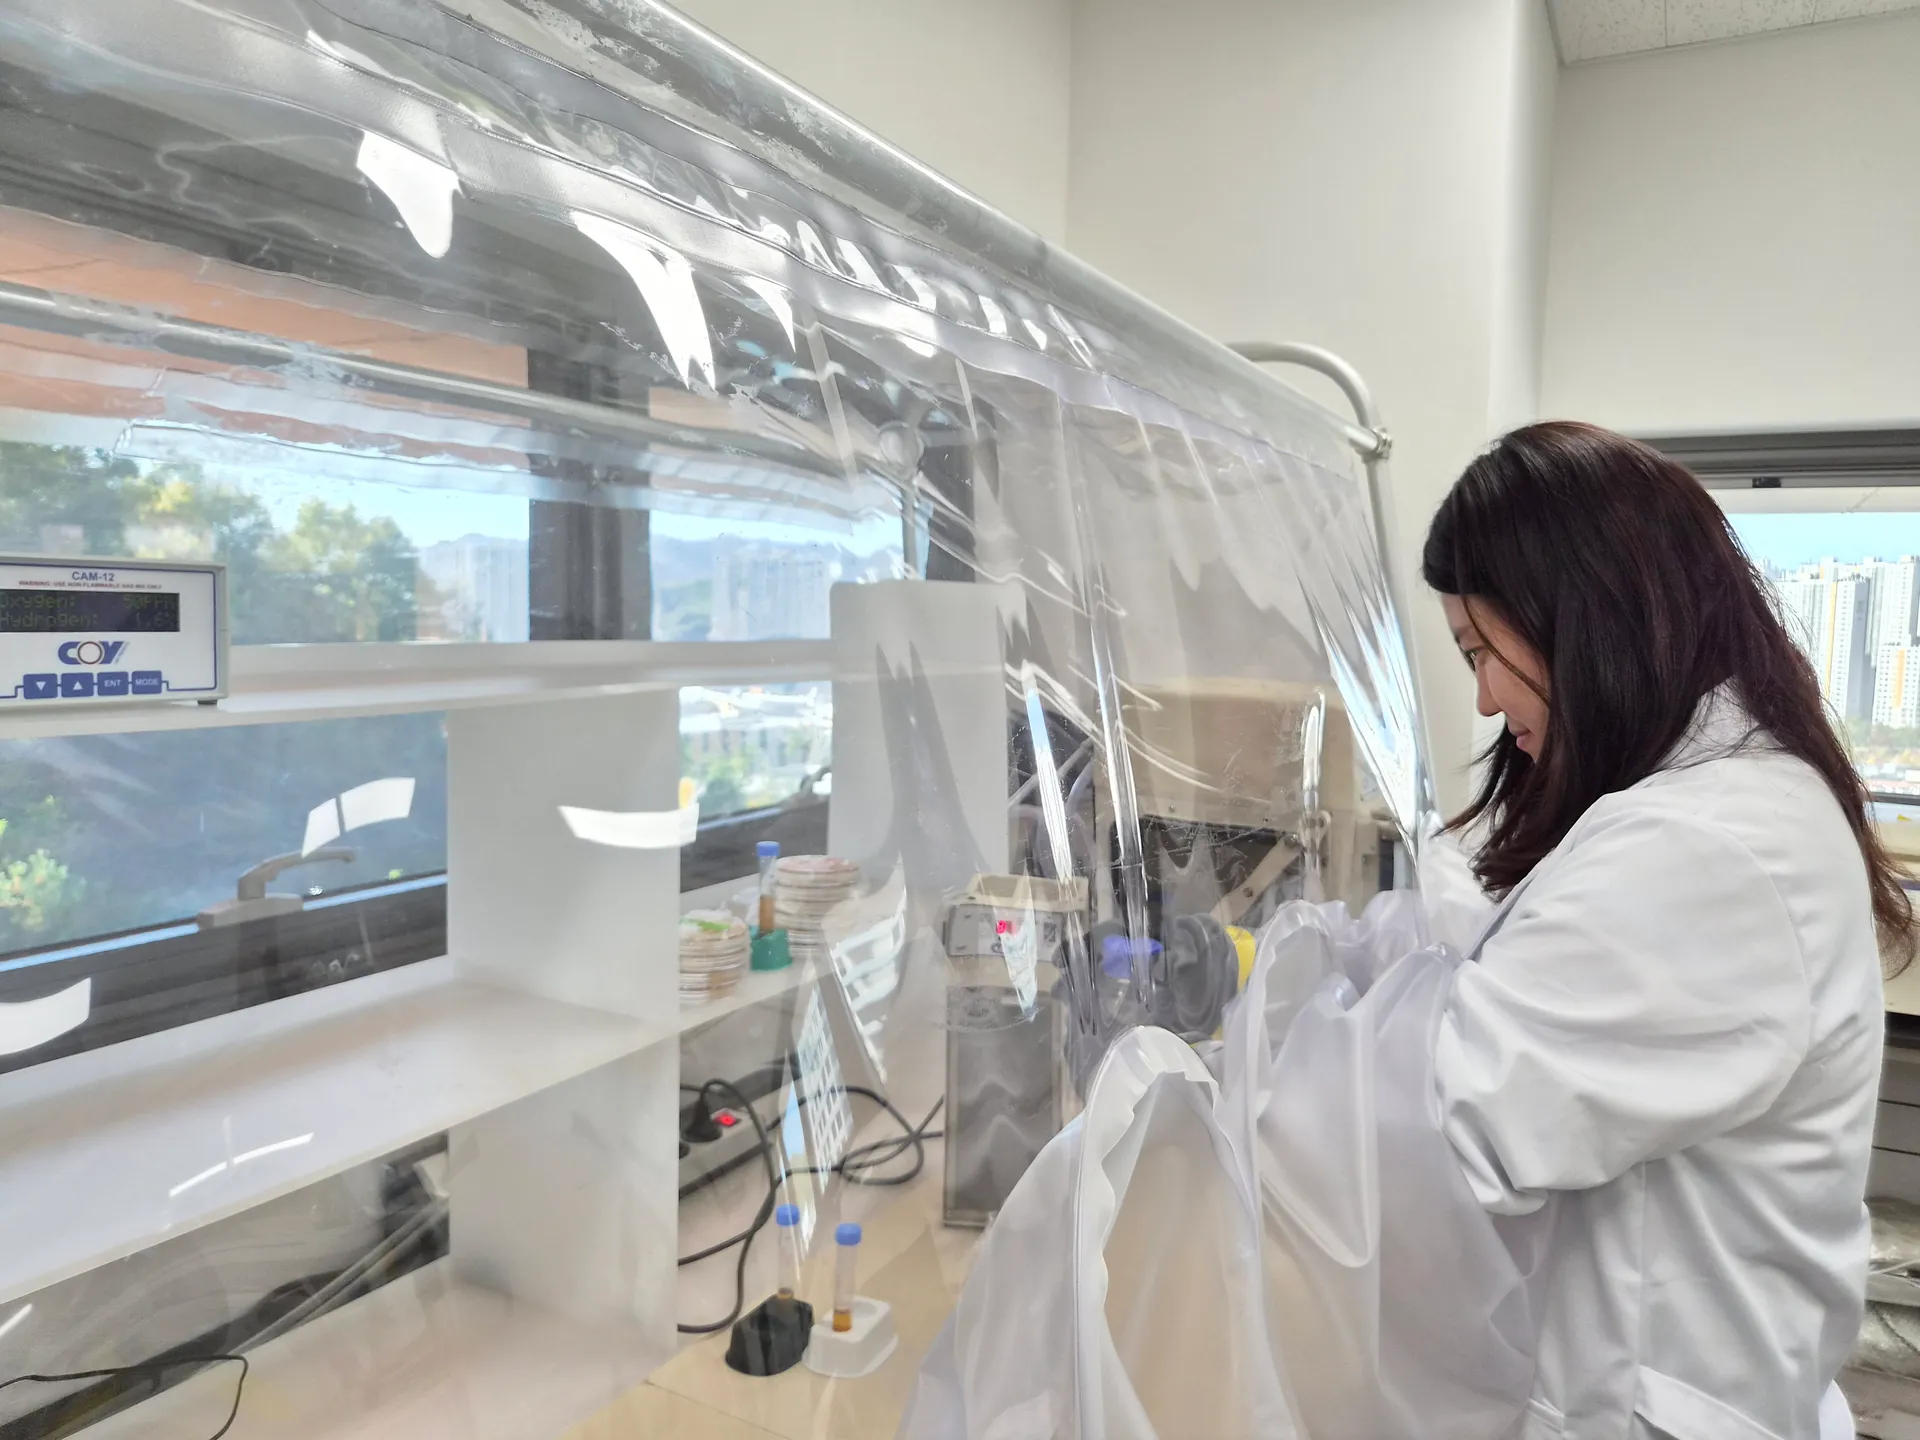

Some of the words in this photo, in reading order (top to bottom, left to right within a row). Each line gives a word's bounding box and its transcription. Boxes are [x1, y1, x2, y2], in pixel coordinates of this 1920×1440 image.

[71, 571, 115, 582] CAM-12
[0, 591, 75, 608] Oxygen:
[0, 610, 98, 628] Hydrogen:
[57, 641, 125, 665] COY
[104, 679, 121, 687] ENT
[135, 677, 159, 686] MODE
